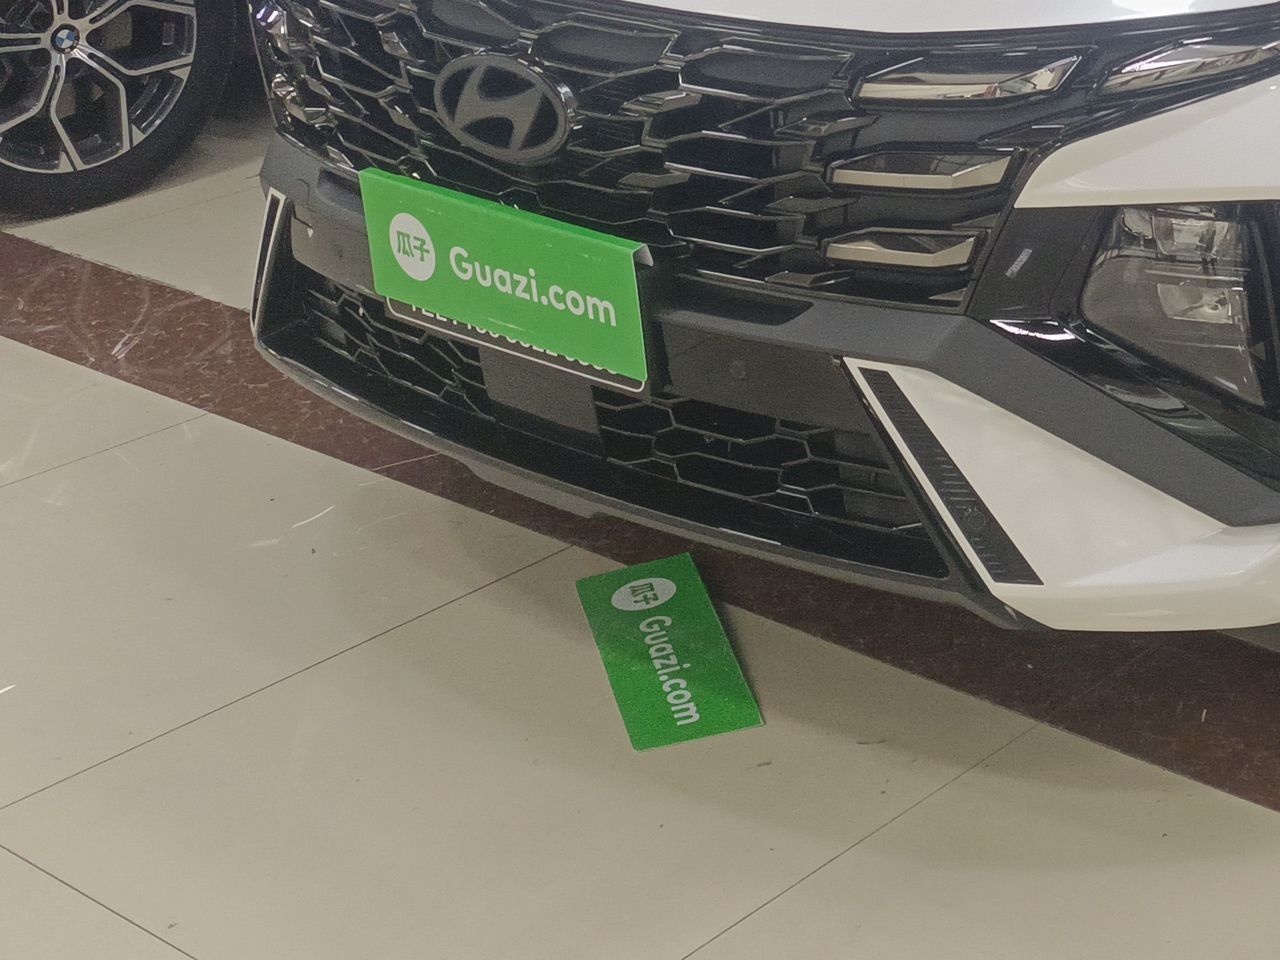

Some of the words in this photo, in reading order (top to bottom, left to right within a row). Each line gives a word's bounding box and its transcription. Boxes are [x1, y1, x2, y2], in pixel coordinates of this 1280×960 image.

[396, 230, 431, 262] 瓜子
[449, 246, 617, 327] Guazi.com
[628, 582, 660, 606] 瓜子
[638, 615, 700, 726] Guazi.com
